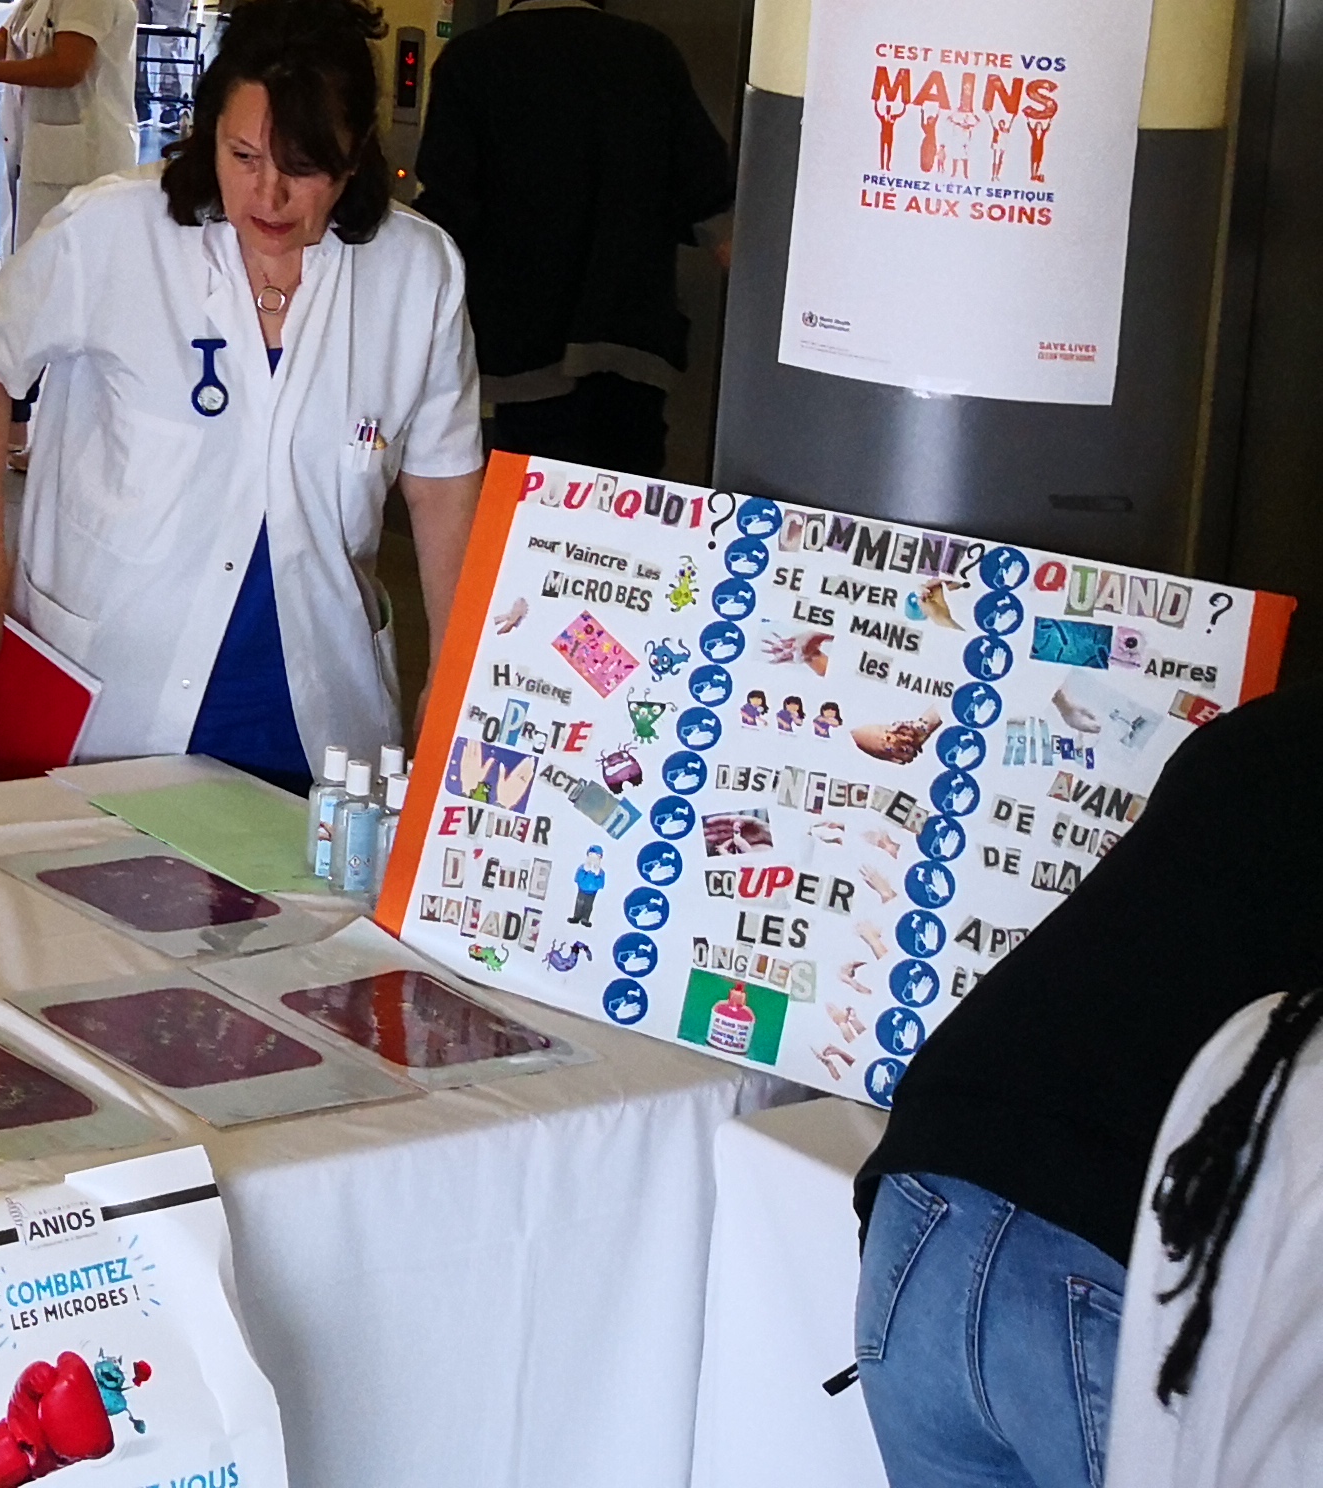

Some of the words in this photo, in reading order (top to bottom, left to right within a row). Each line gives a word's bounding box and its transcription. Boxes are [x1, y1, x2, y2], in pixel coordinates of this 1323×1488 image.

[876, 43, 933, 62] C'EST
[940, 49, 1012, 68] ENTRE
[1020, 54, 1066, 72] VOS
[871, 66, 1058, 120] MAINS
[861, 187, 897, 210] LIÉ
[905, 195, 960, 218] AUX
[970, 202, 1052, 226] SOINS
[863, 173, 930, 191] PRÉVENEZ
[935, 181, 982, 196] L'ÉTAT
[986, 188, 1054, 203] SEPTIQUE
[1069, 344, 1096, 352] LIVES
[528, 536, 560, 553] pour
[565, 542, 628, 571] Vaincre
[636, 563, 661, 580] Les
[773, 568, 805, 591] SE
[820, 576, 898, 608] LAVER
[1034, 561, 1193, 630] QUAND
[793, 601, 835, 626] LES
[850, 615, 919, 651] MAINS
[859, 651, 889, 679] les
[896, 672, 954, 698] MAINS
[992, 798, 1035, 836] DE
[982, 846, 1021, 875] DE
[705, 866, 855, 913] COUPER
[420, 894, 542, 952] MALADE
[737, 912, 809, 949] LES
[693, 937, 816, 1003] ONGLES
[29, 1208, 95, 1241] ANIOS
[6, 1258, 133, 1307] COMBATTEZ
[11, 1309, 38, 1330] LES
[44, 1288, 127, 1323] MICROBES
